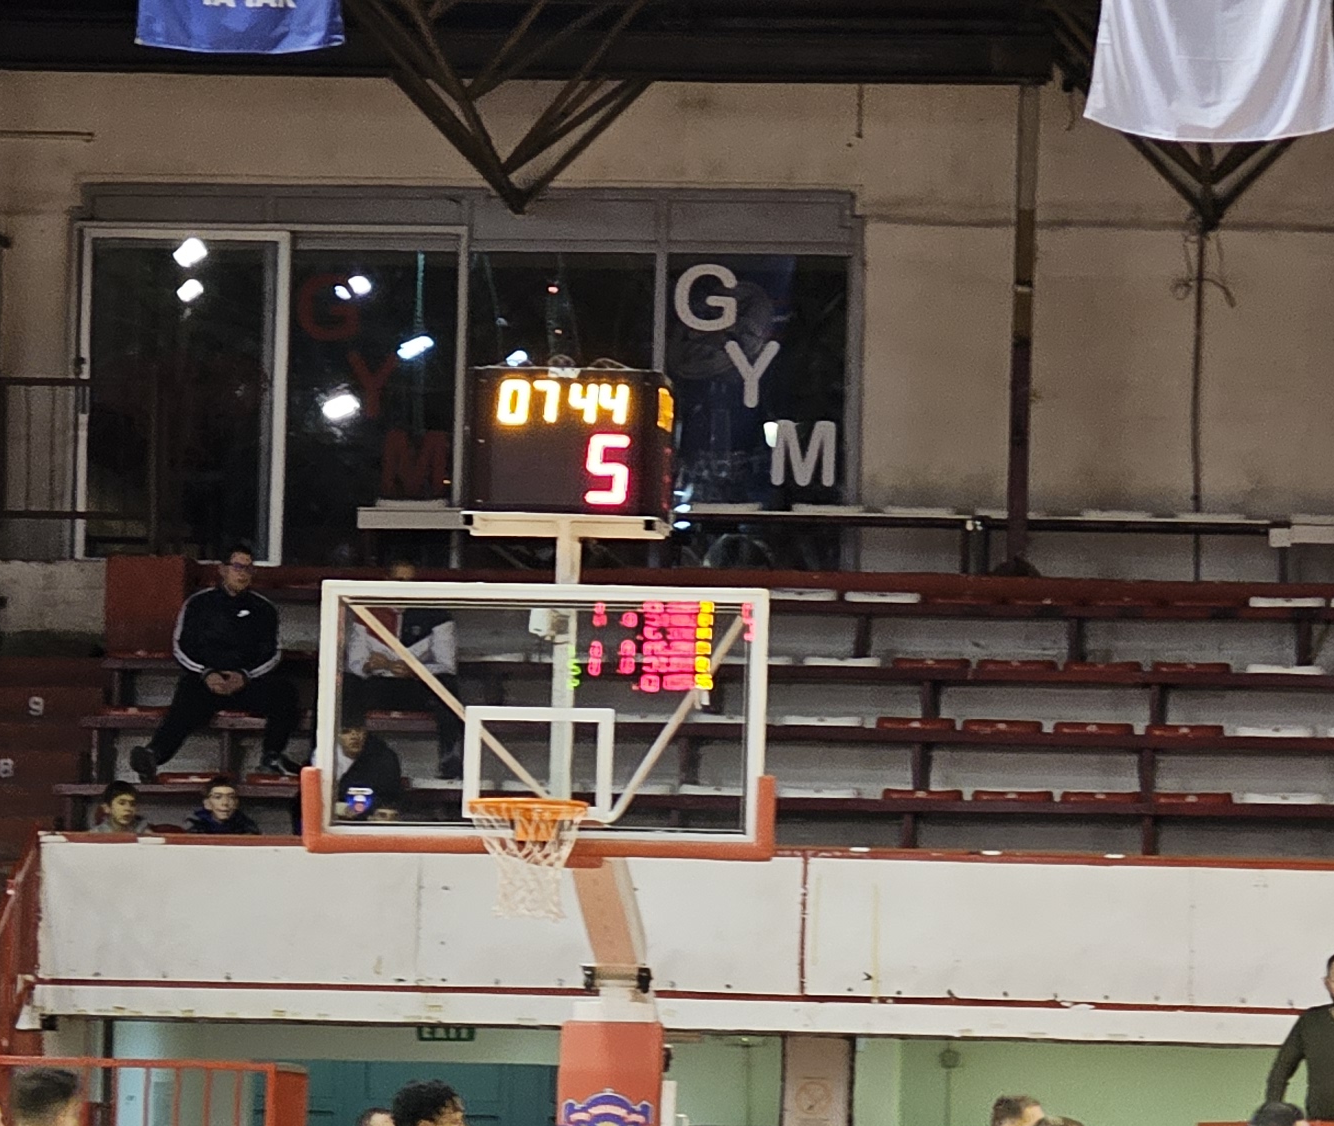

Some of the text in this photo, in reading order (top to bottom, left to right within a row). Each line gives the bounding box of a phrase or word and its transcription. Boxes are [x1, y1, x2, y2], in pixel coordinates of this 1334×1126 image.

[673, 263, 837, 487] GYM
[584, 433, 631, 505] 5
[28, 697, 45, 717] 9
